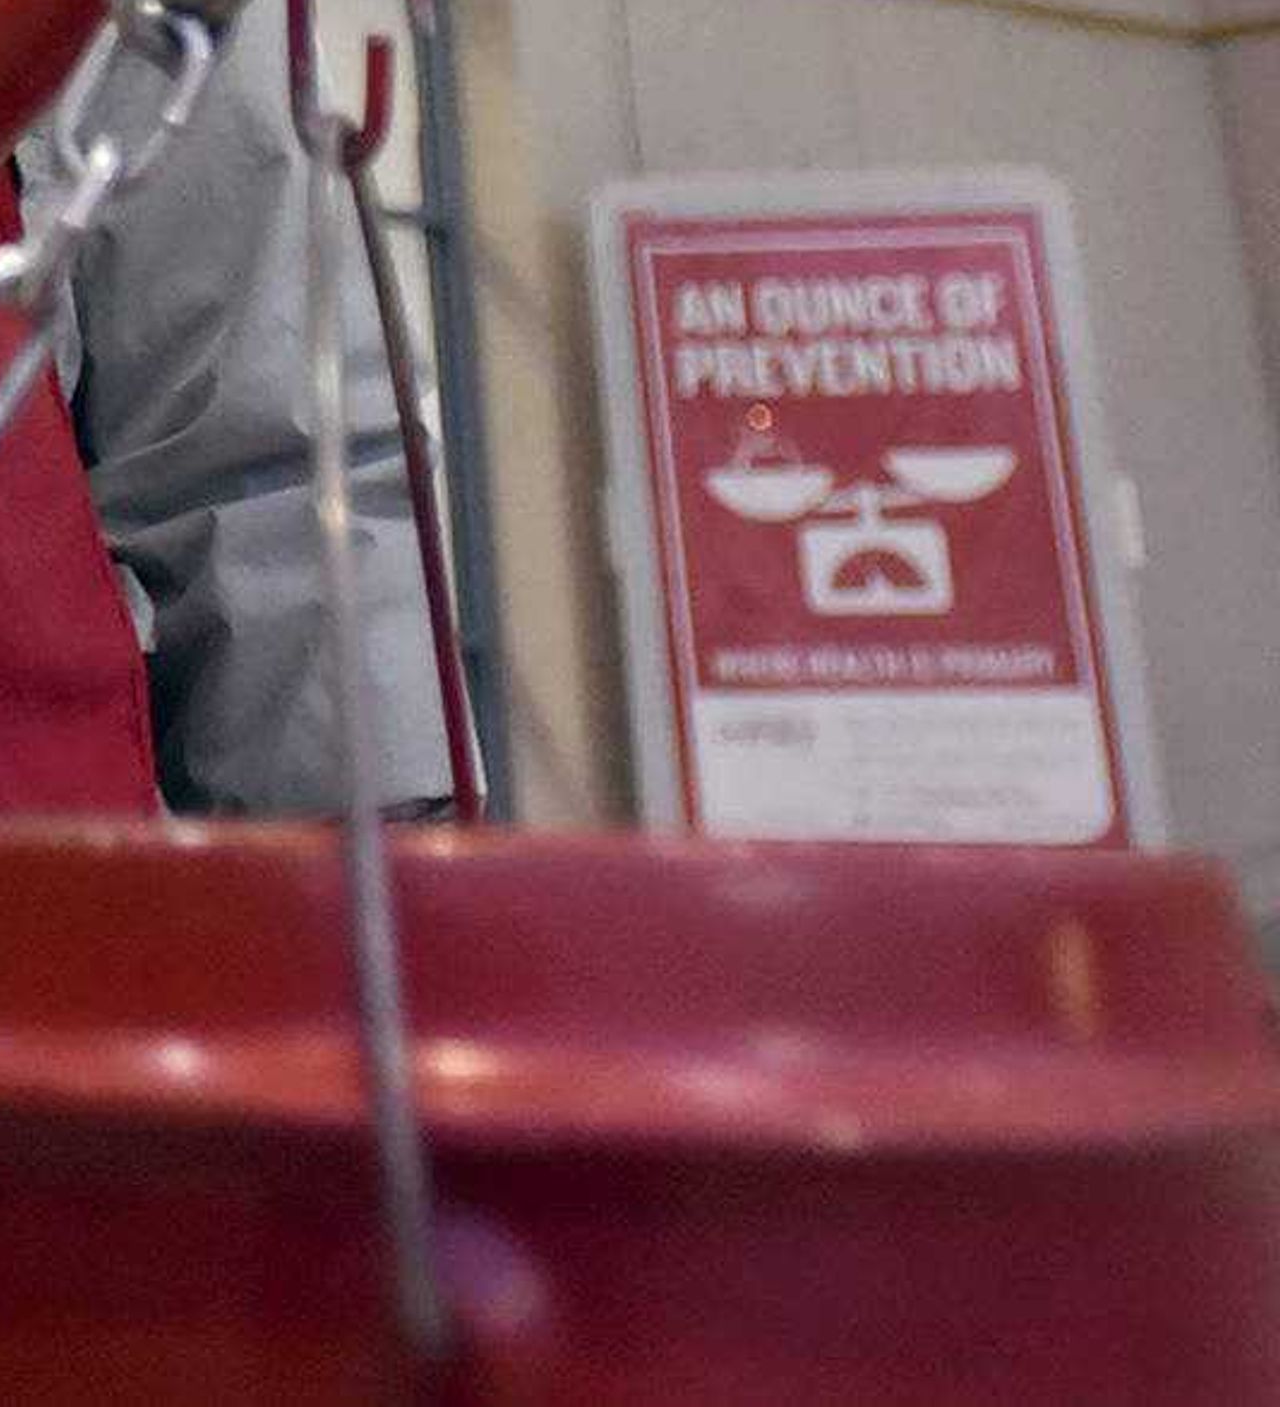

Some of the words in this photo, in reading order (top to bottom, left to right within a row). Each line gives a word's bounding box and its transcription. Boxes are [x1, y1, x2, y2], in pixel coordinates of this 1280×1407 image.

[674, 280, 745, 332] AN
[752, 276, 932, 330] OUNCE
[938, 272, 1002, 328] OF
[672, 336, 1020, 398] PREVENTION
